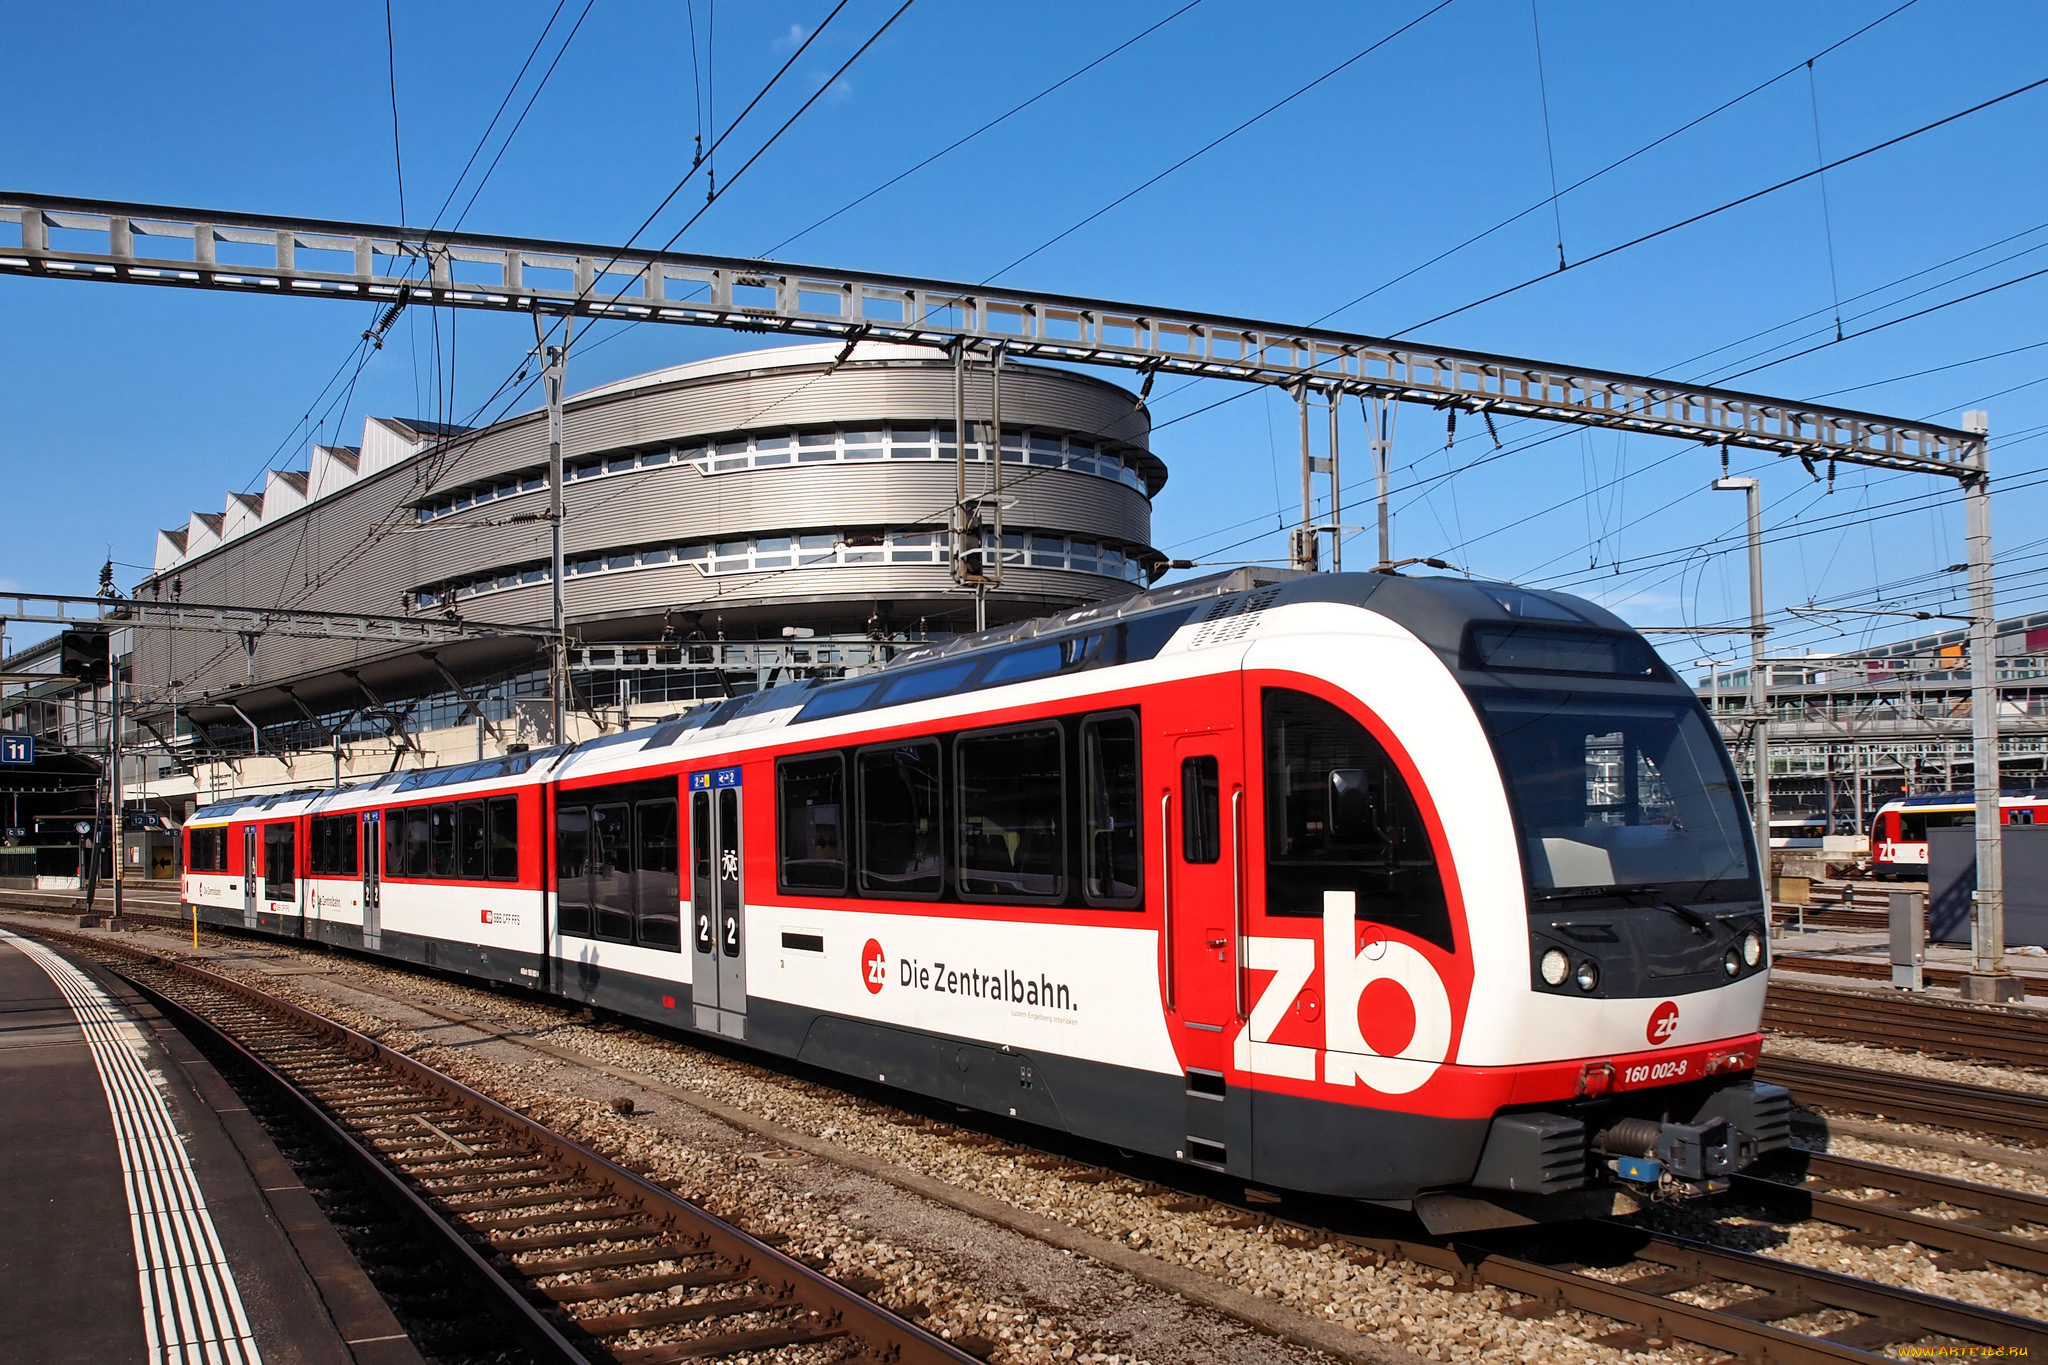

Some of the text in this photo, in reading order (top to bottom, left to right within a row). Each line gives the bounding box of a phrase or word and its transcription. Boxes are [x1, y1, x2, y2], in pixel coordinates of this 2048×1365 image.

[8, 743, 24, 760] 11
[134, 816, 156, 825] 12 D
[365, 886, 370, 901] 2
[374, 886, 379, 902] 2
[493, 912, 502, 924] SBB
[700, 914, 709, 942] 2
[727, 916, 736, 945] 2
[868, 953, 887, 985] zb
[900, 958, 1078, 1012] Die Zentralbahn.
[1234, 891, 1451, 1094] zb
[1028, 1011, 1053, 1024] Engelberg
[1654, 1012, 1679, 1036] zb
[1625, 1060, 1688, 1083] 160 002-8
